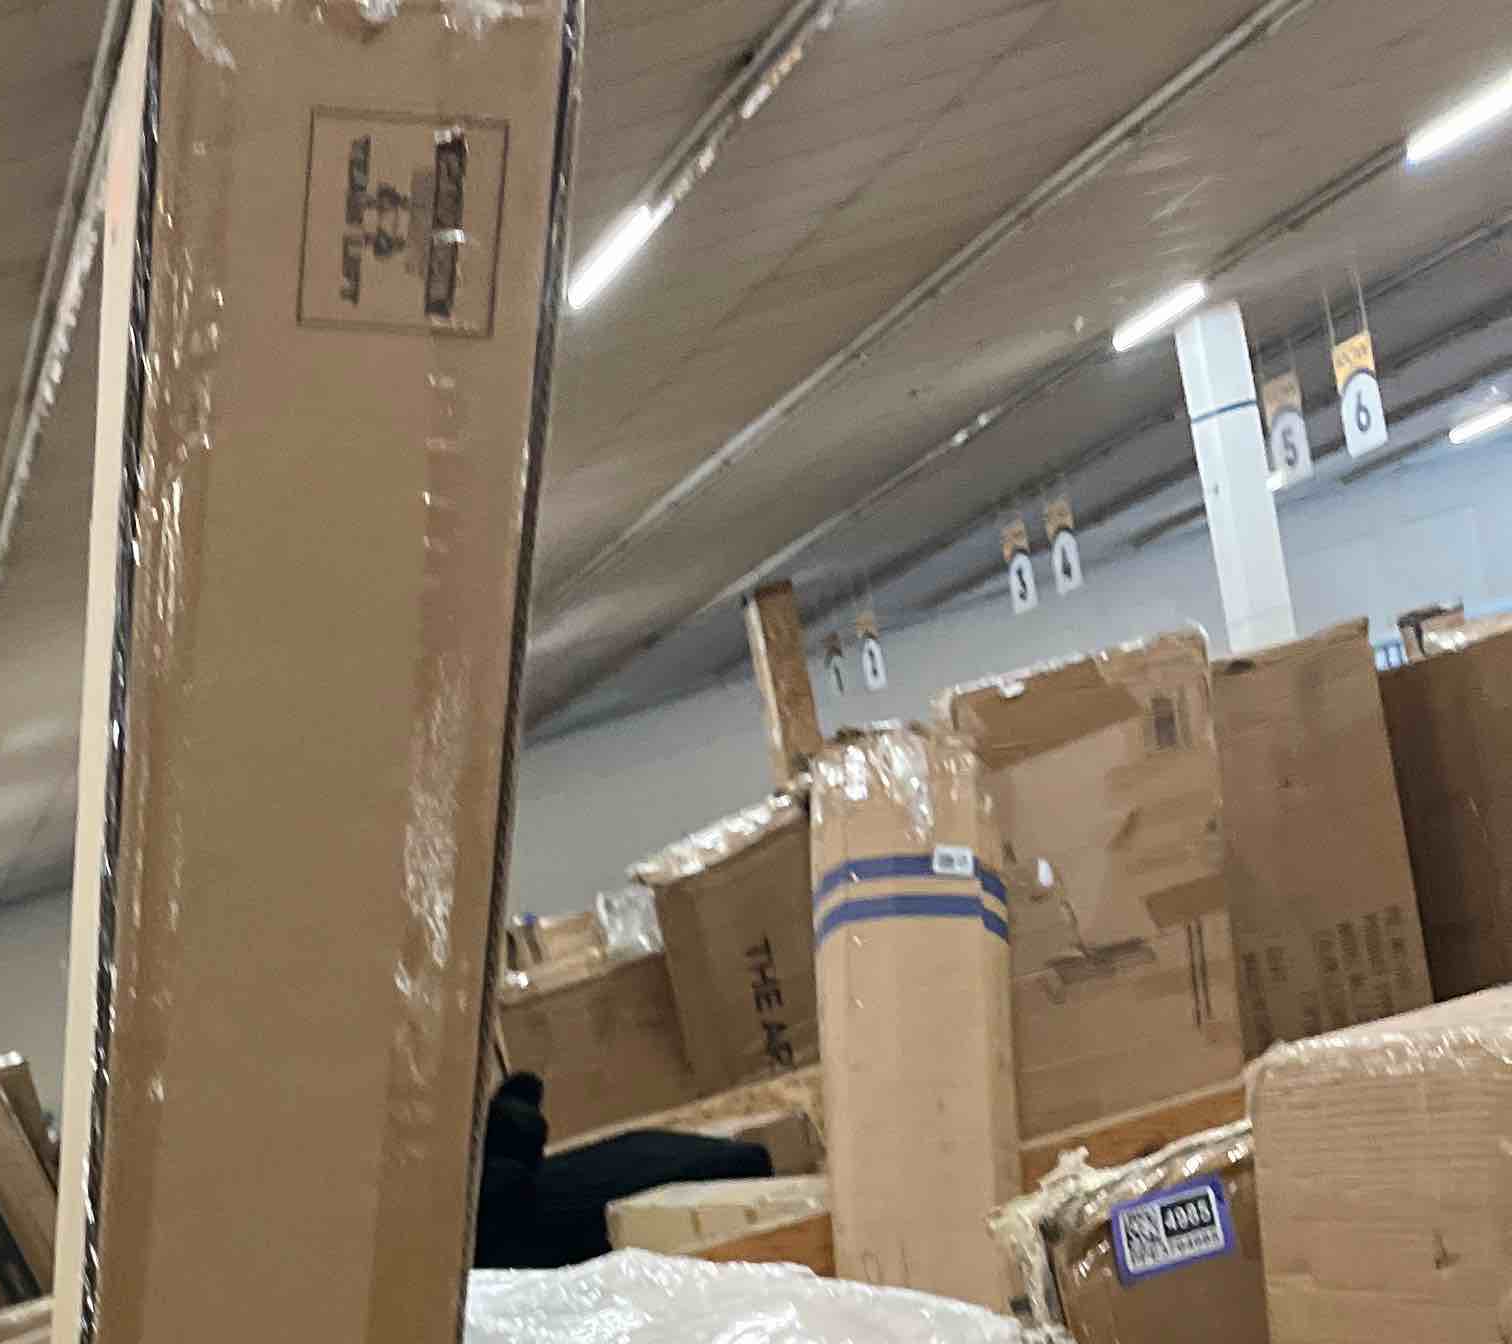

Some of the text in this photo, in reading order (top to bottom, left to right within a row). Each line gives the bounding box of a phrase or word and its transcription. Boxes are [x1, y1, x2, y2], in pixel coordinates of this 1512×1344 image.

[1352, 392, 1372, 434] 6
[1278, 428, 1300, 466] 5
[742, 934, 785, 1012] THE
